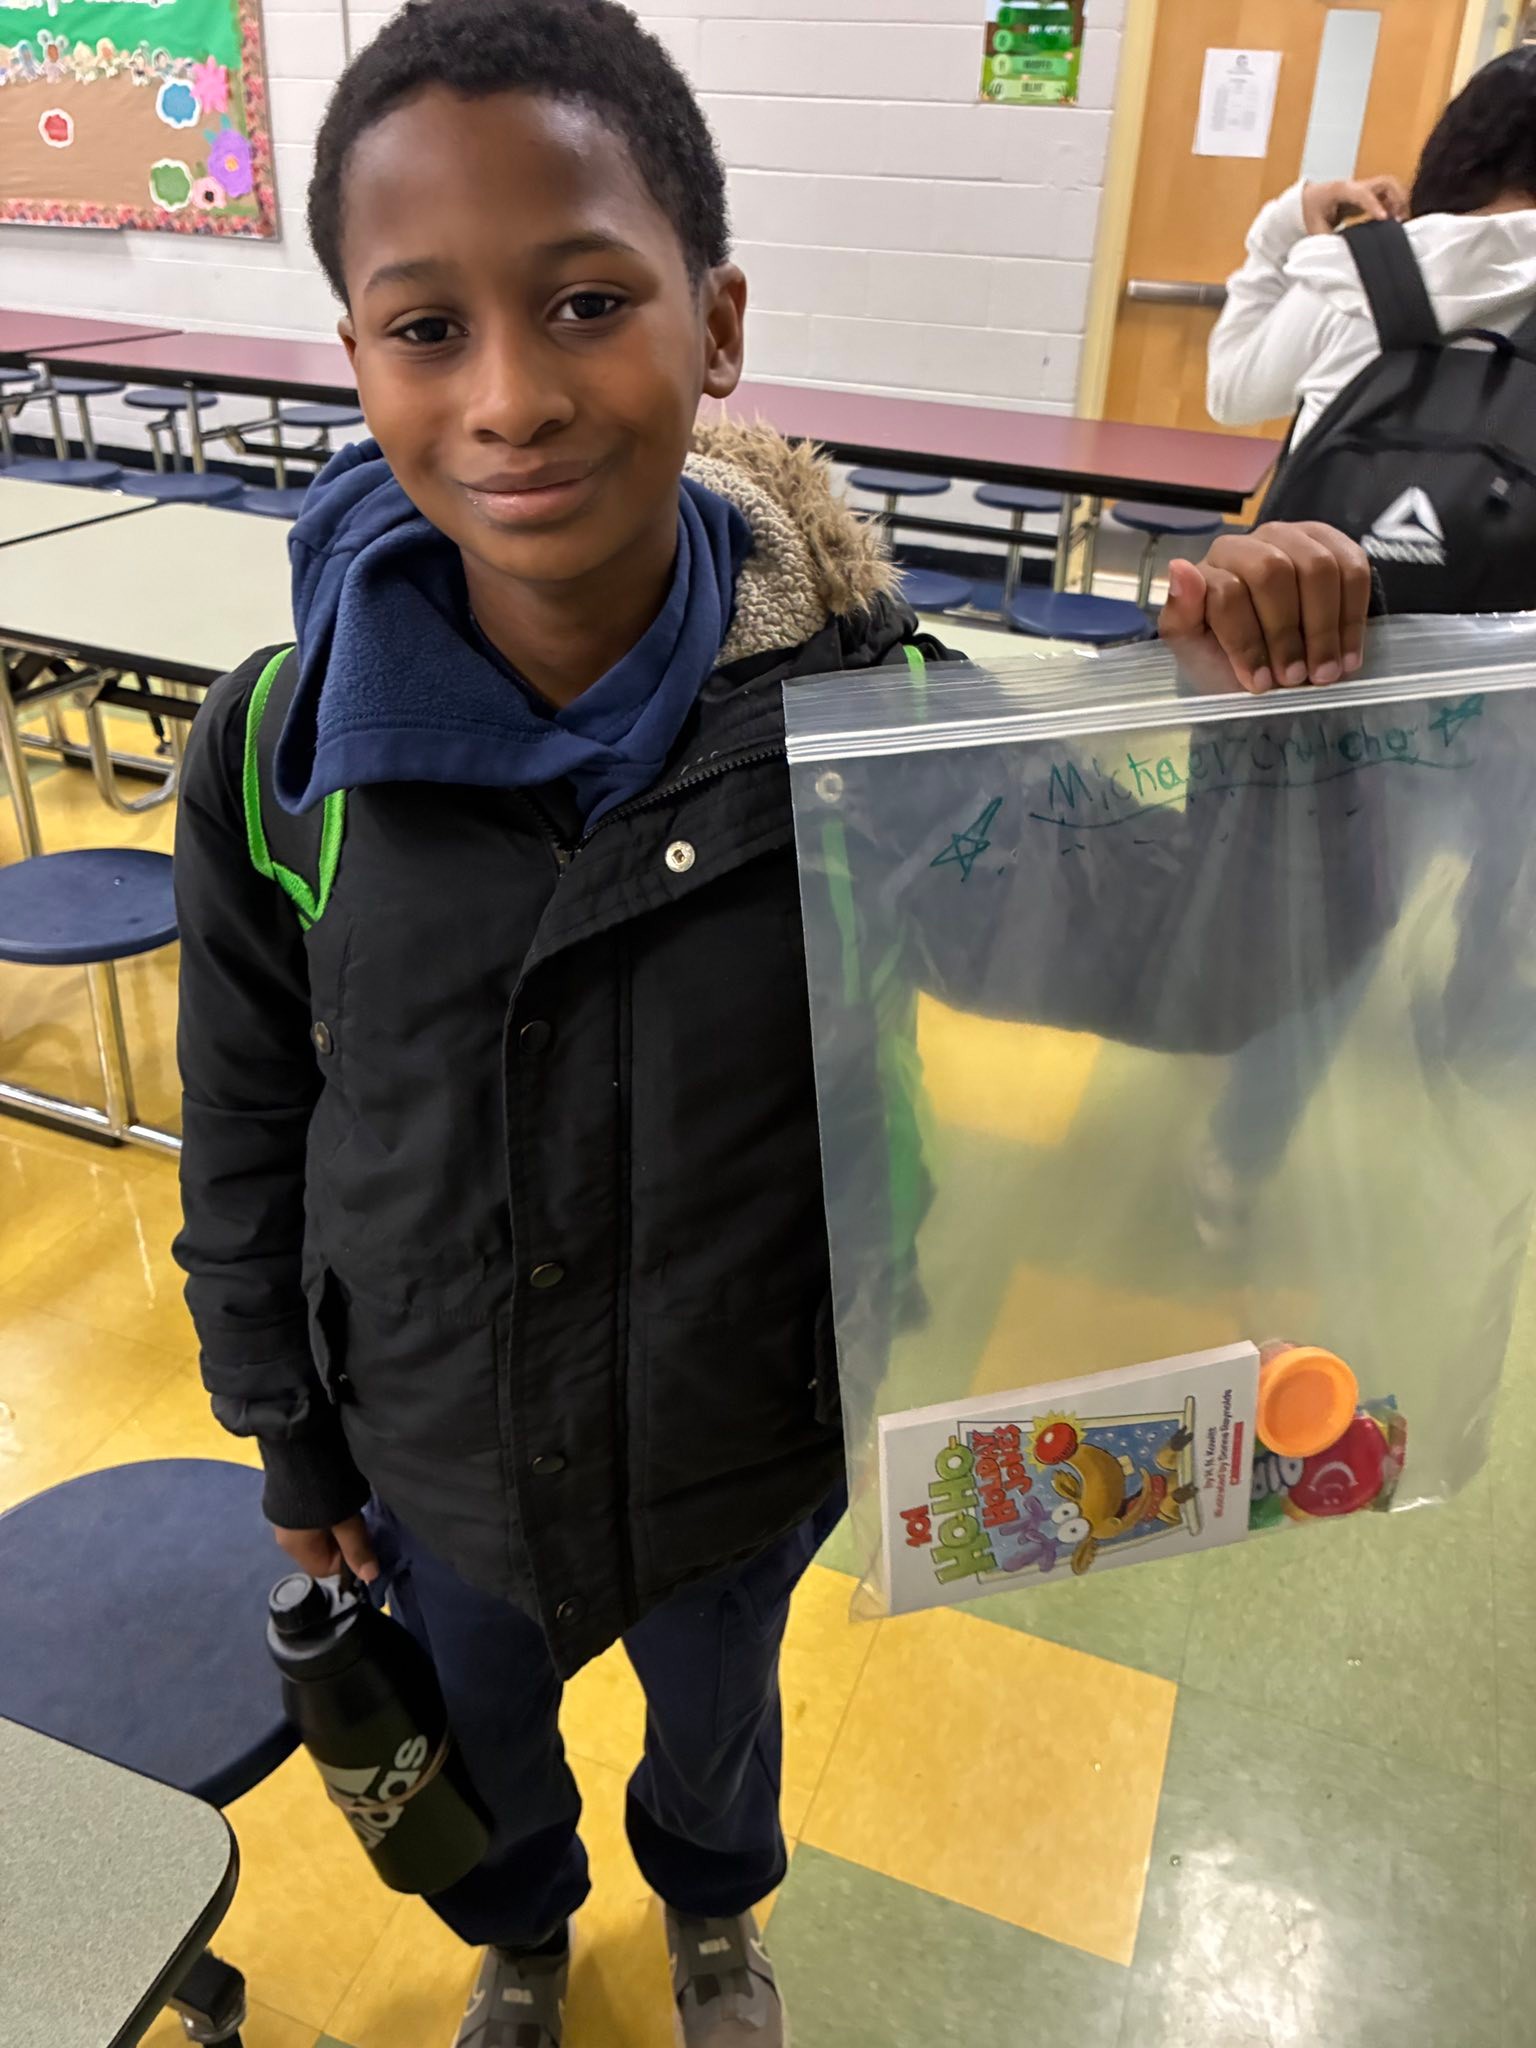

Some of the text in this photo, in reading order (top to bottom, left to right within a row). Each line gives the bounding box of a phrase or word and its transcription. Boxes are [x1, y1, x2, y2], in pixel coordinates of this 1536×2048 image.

[1049, 741, 1225, 811] Michael
[972, 1429, 1021, 1529] HOLIDAY
[993, 1424, 1034, 1496] JOKES
[900, 1504, 933, 1548] 101
